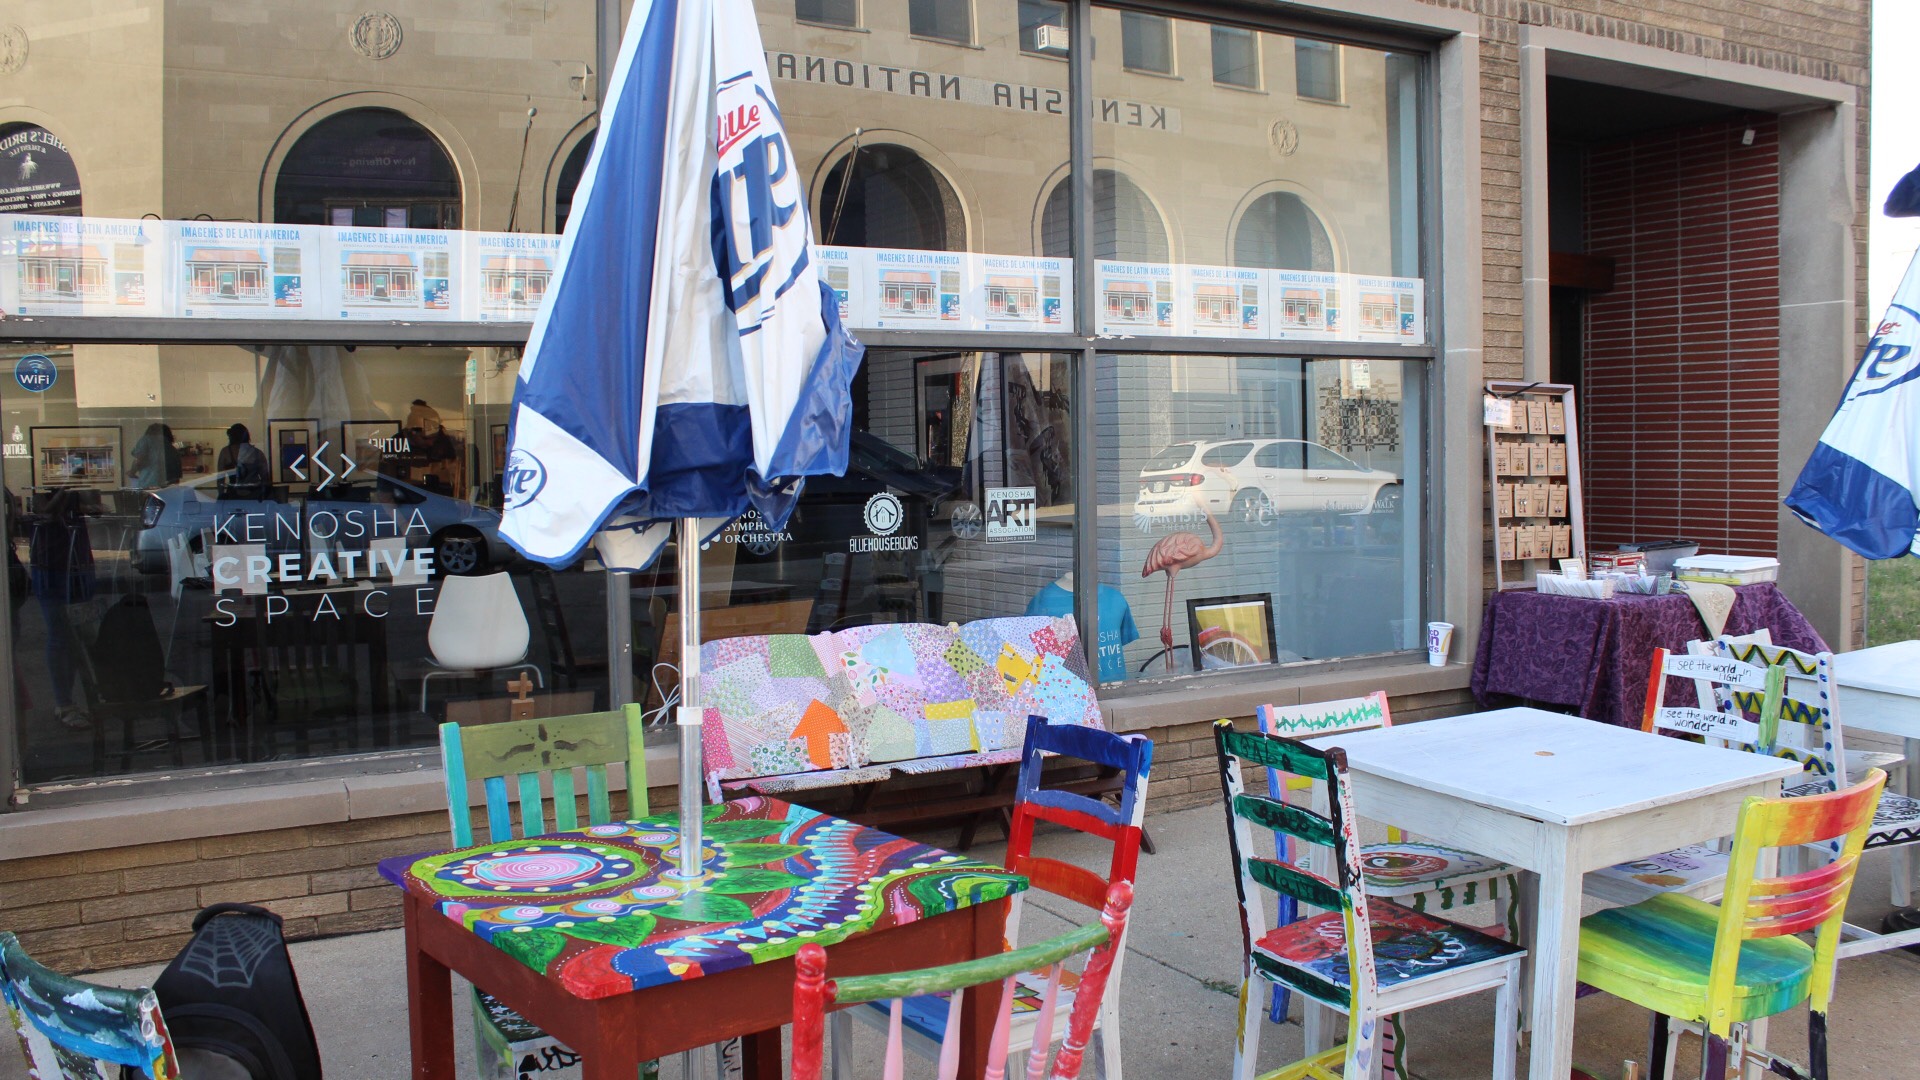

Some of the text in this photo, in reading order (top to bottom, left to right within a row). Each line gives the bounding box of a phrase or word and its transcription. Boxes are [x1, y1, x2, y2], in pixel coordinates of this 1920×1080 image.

[14, 221, 143, 236] IMAGENES DE LATIN AMERICA
[182, 227, 300, 240] IMAGENES DE LATIN AMERICA
[338, 232, 448, 245] IMAGENES DE LATIN AMERICA
[479, 237, 514, 247] IMAGENES
[517, 238, 525, 248] DE
[528, 238, 548, 248] LATIN
[822, 251, 848, 260] AMERICA
[877, 253, 959, 265] IMAGENES DE LATIN AMERICA
[983, 259, 1010, 268] IMAGENES
[1019, 260, 1034, 269] LATIN
[1037, 261, 1059, 270] AMERICA
[1102, 264, 1125, 274] IMAGENES
[1134, 266, 1149, 275] LATIN
[1150, 266, 1172, 276] AMERICA
[20, 374, 50, 384] WiFi
[1374, 500, 1394, 509] WALK
[987, 499, 1034, 527] ART
[1152, 508, 1208, 523] ARTISTS
[214, 508, 431, 542] KENOSHA
[725, 532, 793, 543] ORCHESTRA
[850, 536, 918, 552] BLUEHOUSEBOOKS
[213, 548, 436, 584] CREATIVE
[215, 588, 434, 627] SPACE
[1677, 660, 1694, 670] see
[1697, 659, 1712, 671] the
[1713, 664, 1736, 674] world
[1743, 668, 1752, 677] in
[1719, 673, 1743, 682] LIGHT
[1666, 710, 1682, 719] see
[1686, 710, 1700, 719] the
[1703, 714, 1726, 724] world
[1729, 718, 1738, 726] in
[1674, 719, 1714, 732] wonder
